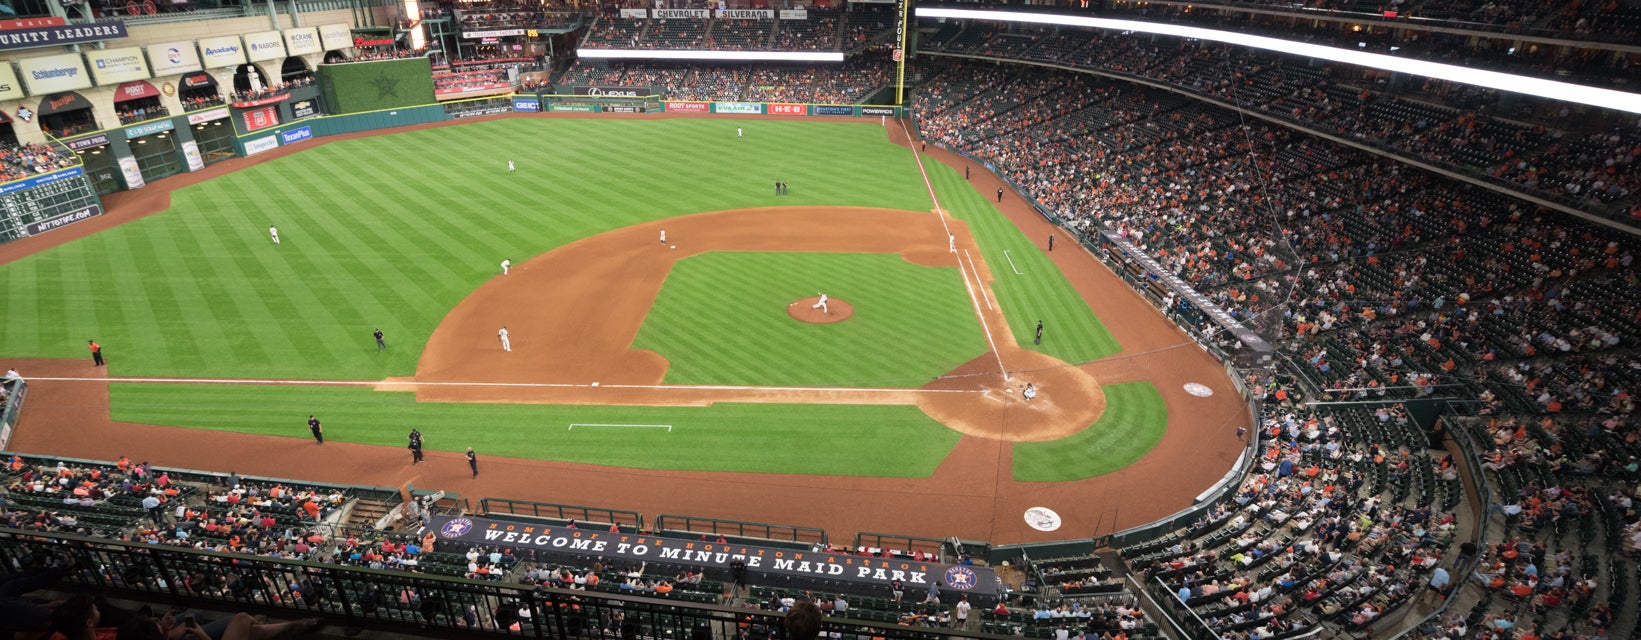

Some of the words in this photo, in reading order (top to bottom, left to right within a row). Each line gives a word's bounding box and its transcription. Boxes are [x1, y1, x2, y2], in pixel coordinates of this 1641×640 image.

[657, 10, 704, 18] CHEVROLET
[722, 10, 768, 18] SILVERADO
[55, 26, 119, 40] LEADERS
[105, 55, 138, 64] CHAMPION
[32, 67, 78, 80] Schlumberger
[125, 84, 144, 93] ROOT
[284, 130, 310, 142] TexanPlus
[77, 138, 90, 148] TOWN
[38, 209, 90, 231] NITTOTIRE.COM
[488, 523, 551, 534] HOME
[621, 536, 663, 546] THE
[686, 542, 803, 559] HOUSTON
[828, 556, 926, 572] ASTROS
[485, 529, 607, 552] WELCOME
[617, 543, 648, 555] TO
[660, 547, 762, 567] MINUTE
[773, 558, 844, 575] MAID
[857, 566, 926, 584] PARK
